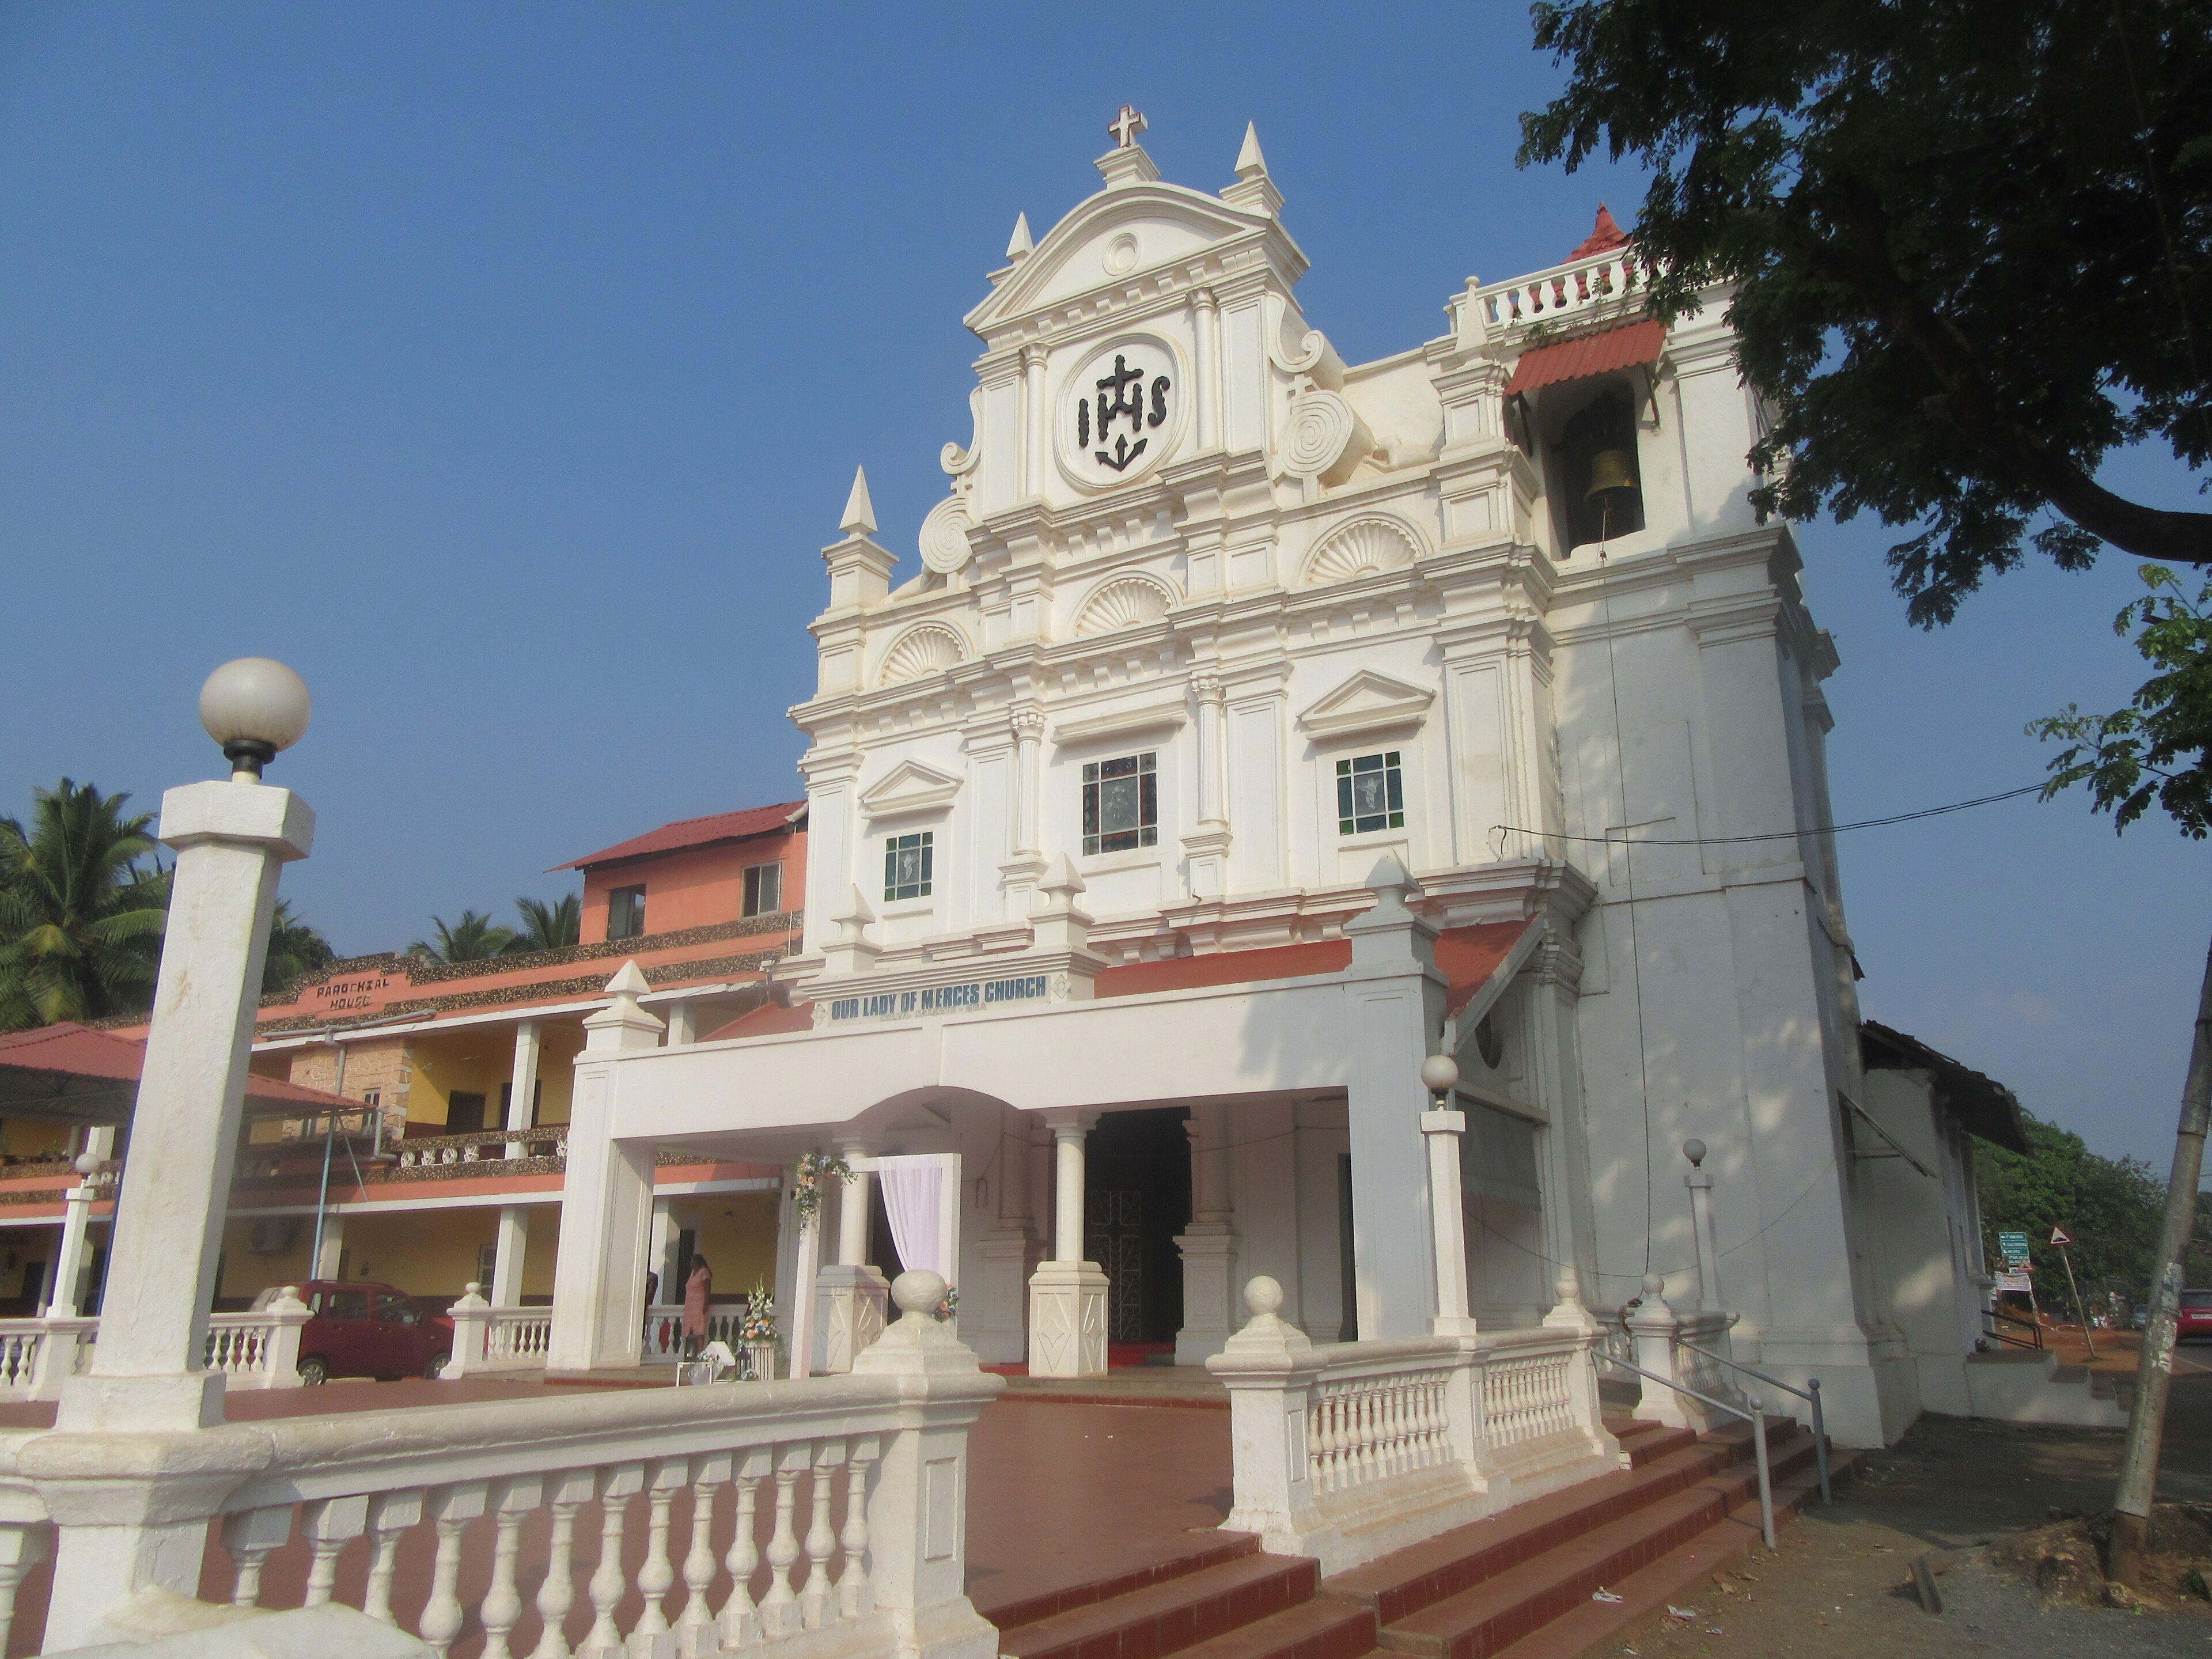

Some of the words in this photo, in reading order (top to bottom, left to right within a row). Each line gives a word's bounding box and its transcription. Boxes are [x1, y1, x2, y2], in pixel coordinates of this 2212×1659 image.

[331, 995, 372, 1009] HOUSE
[832, 999, 858, 1020] OUR
[863, 994, 897, 1017] LADY
[901, 991, 917, 1012] OF
[922, 984, 979, 1009] MERCES
[985, 976, 1046, 1002] CHURCH
[967, 1003, 987, 1012] GOA
